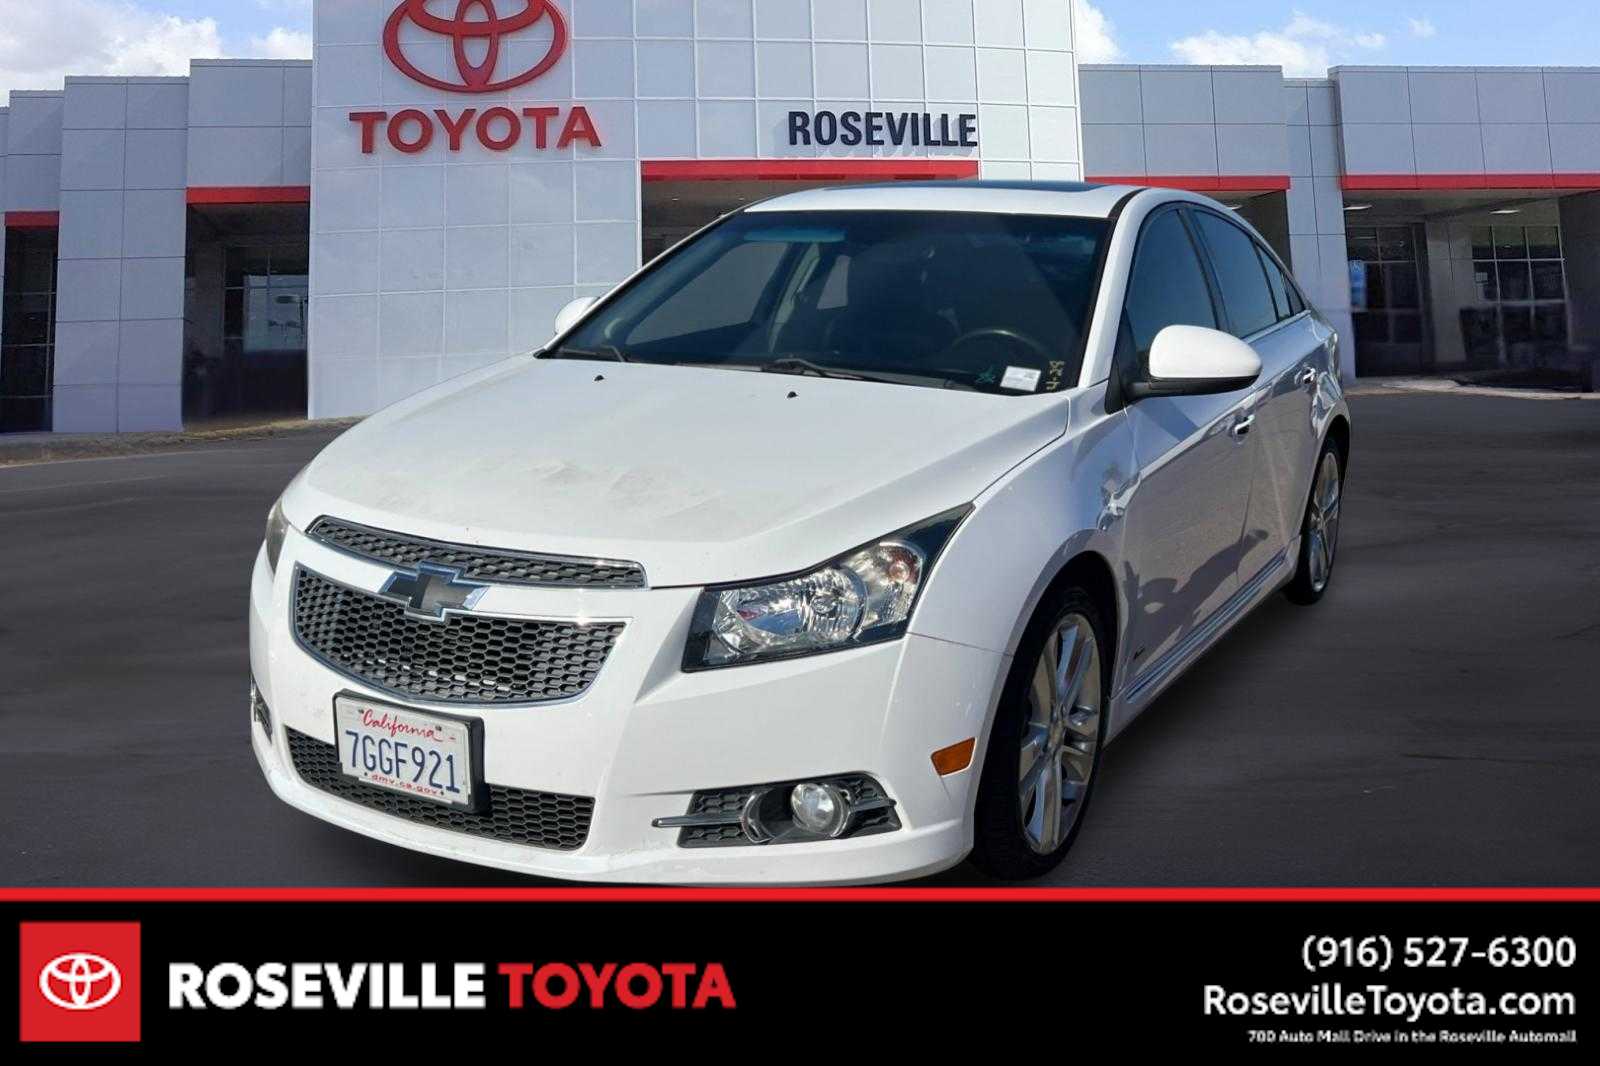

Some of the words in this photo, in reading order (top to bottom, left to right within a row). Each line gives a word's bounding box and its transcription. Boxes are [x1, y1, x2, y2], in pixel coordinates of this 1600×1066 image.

[349, 106, 603, 154] TOYOTA
[788, 111, 978, 148] ROSEVILLE
[362, 708, 443, 742] California
[345, 730, 460, 794] 7GGF921
